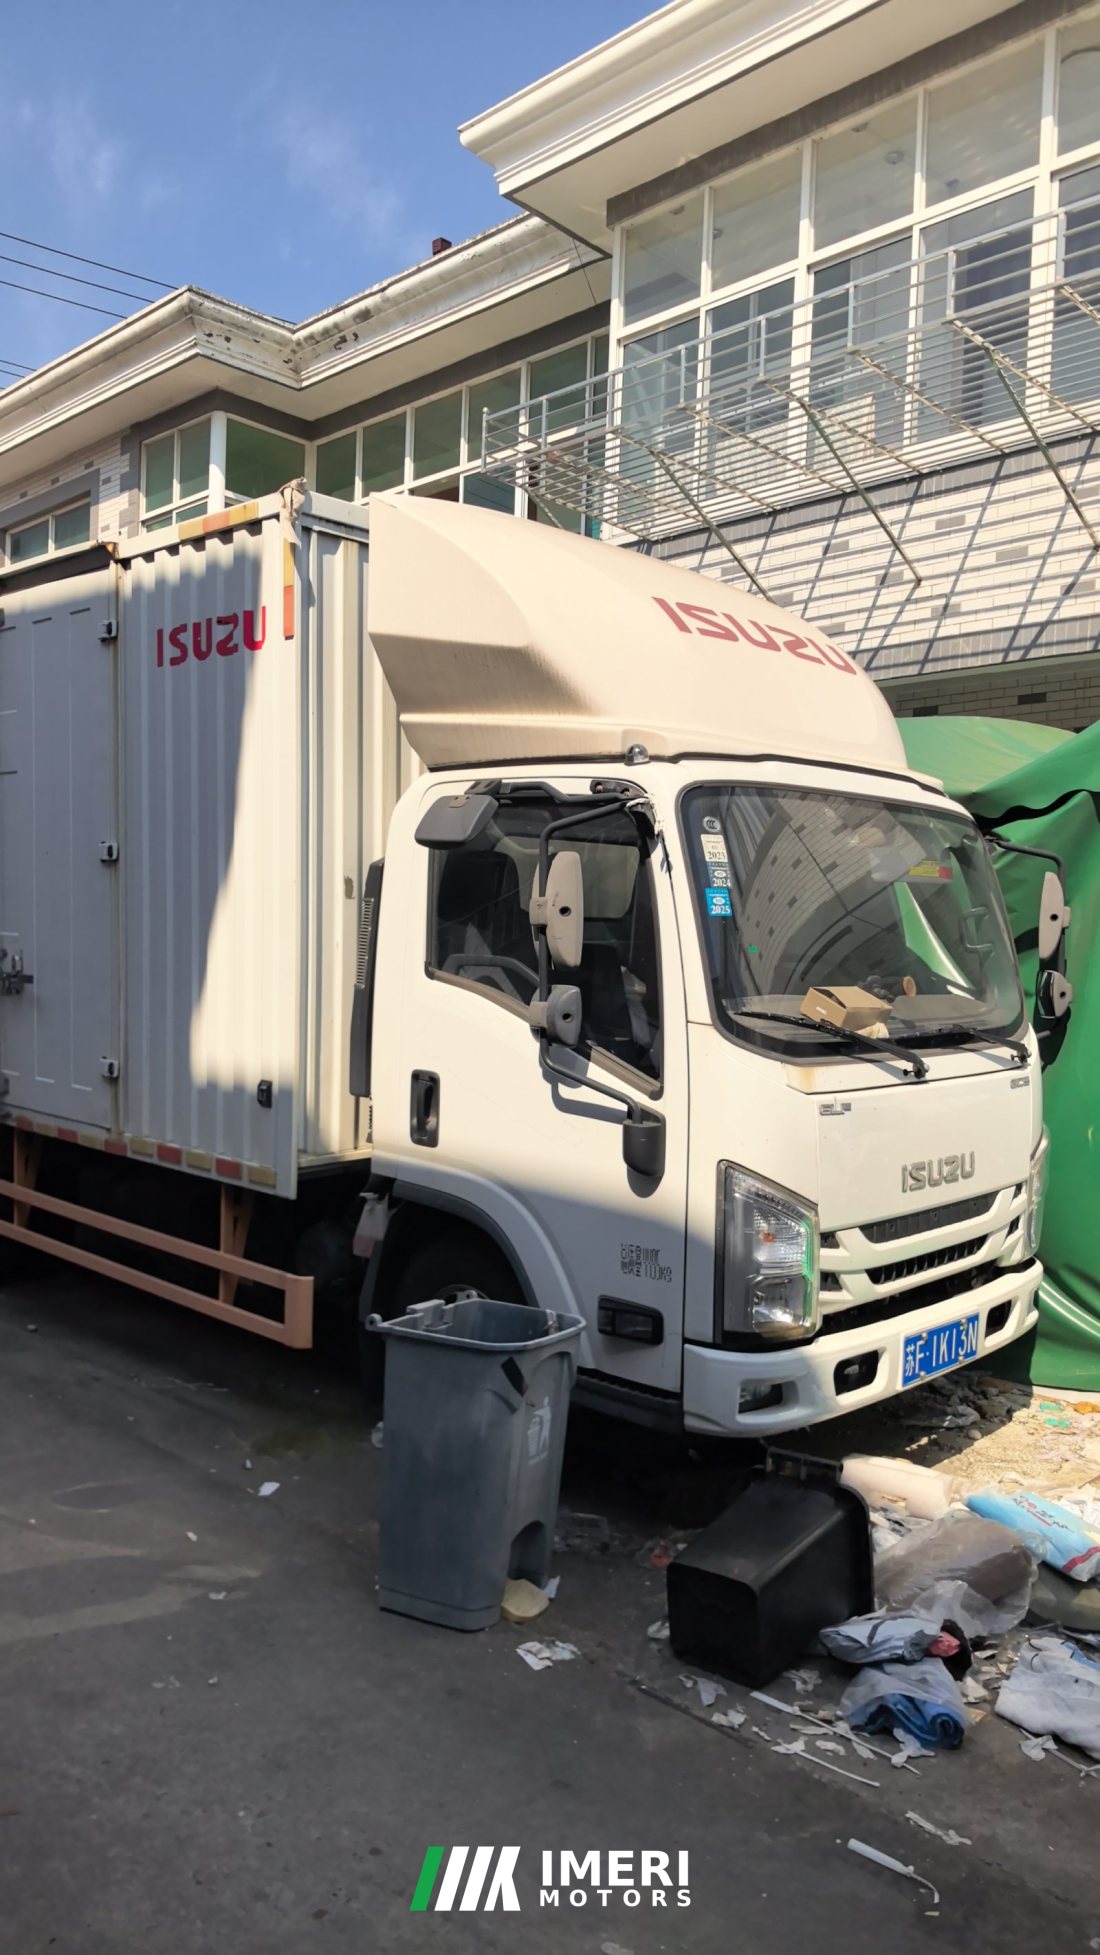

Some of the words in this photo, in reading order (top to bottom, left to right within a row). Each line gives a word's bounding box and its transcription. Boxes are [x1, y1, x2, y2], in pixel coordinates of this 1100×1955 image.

[157, 606, 266, 668] ISUZU
[651, 596, 857, 675] ISUZU
[707, 850, 726, 860] 2023
[713, 877, 731, 887] 2024
[710, 904, 730, 914] 2025
[901, 1151, 976, 1194] ISUZU
